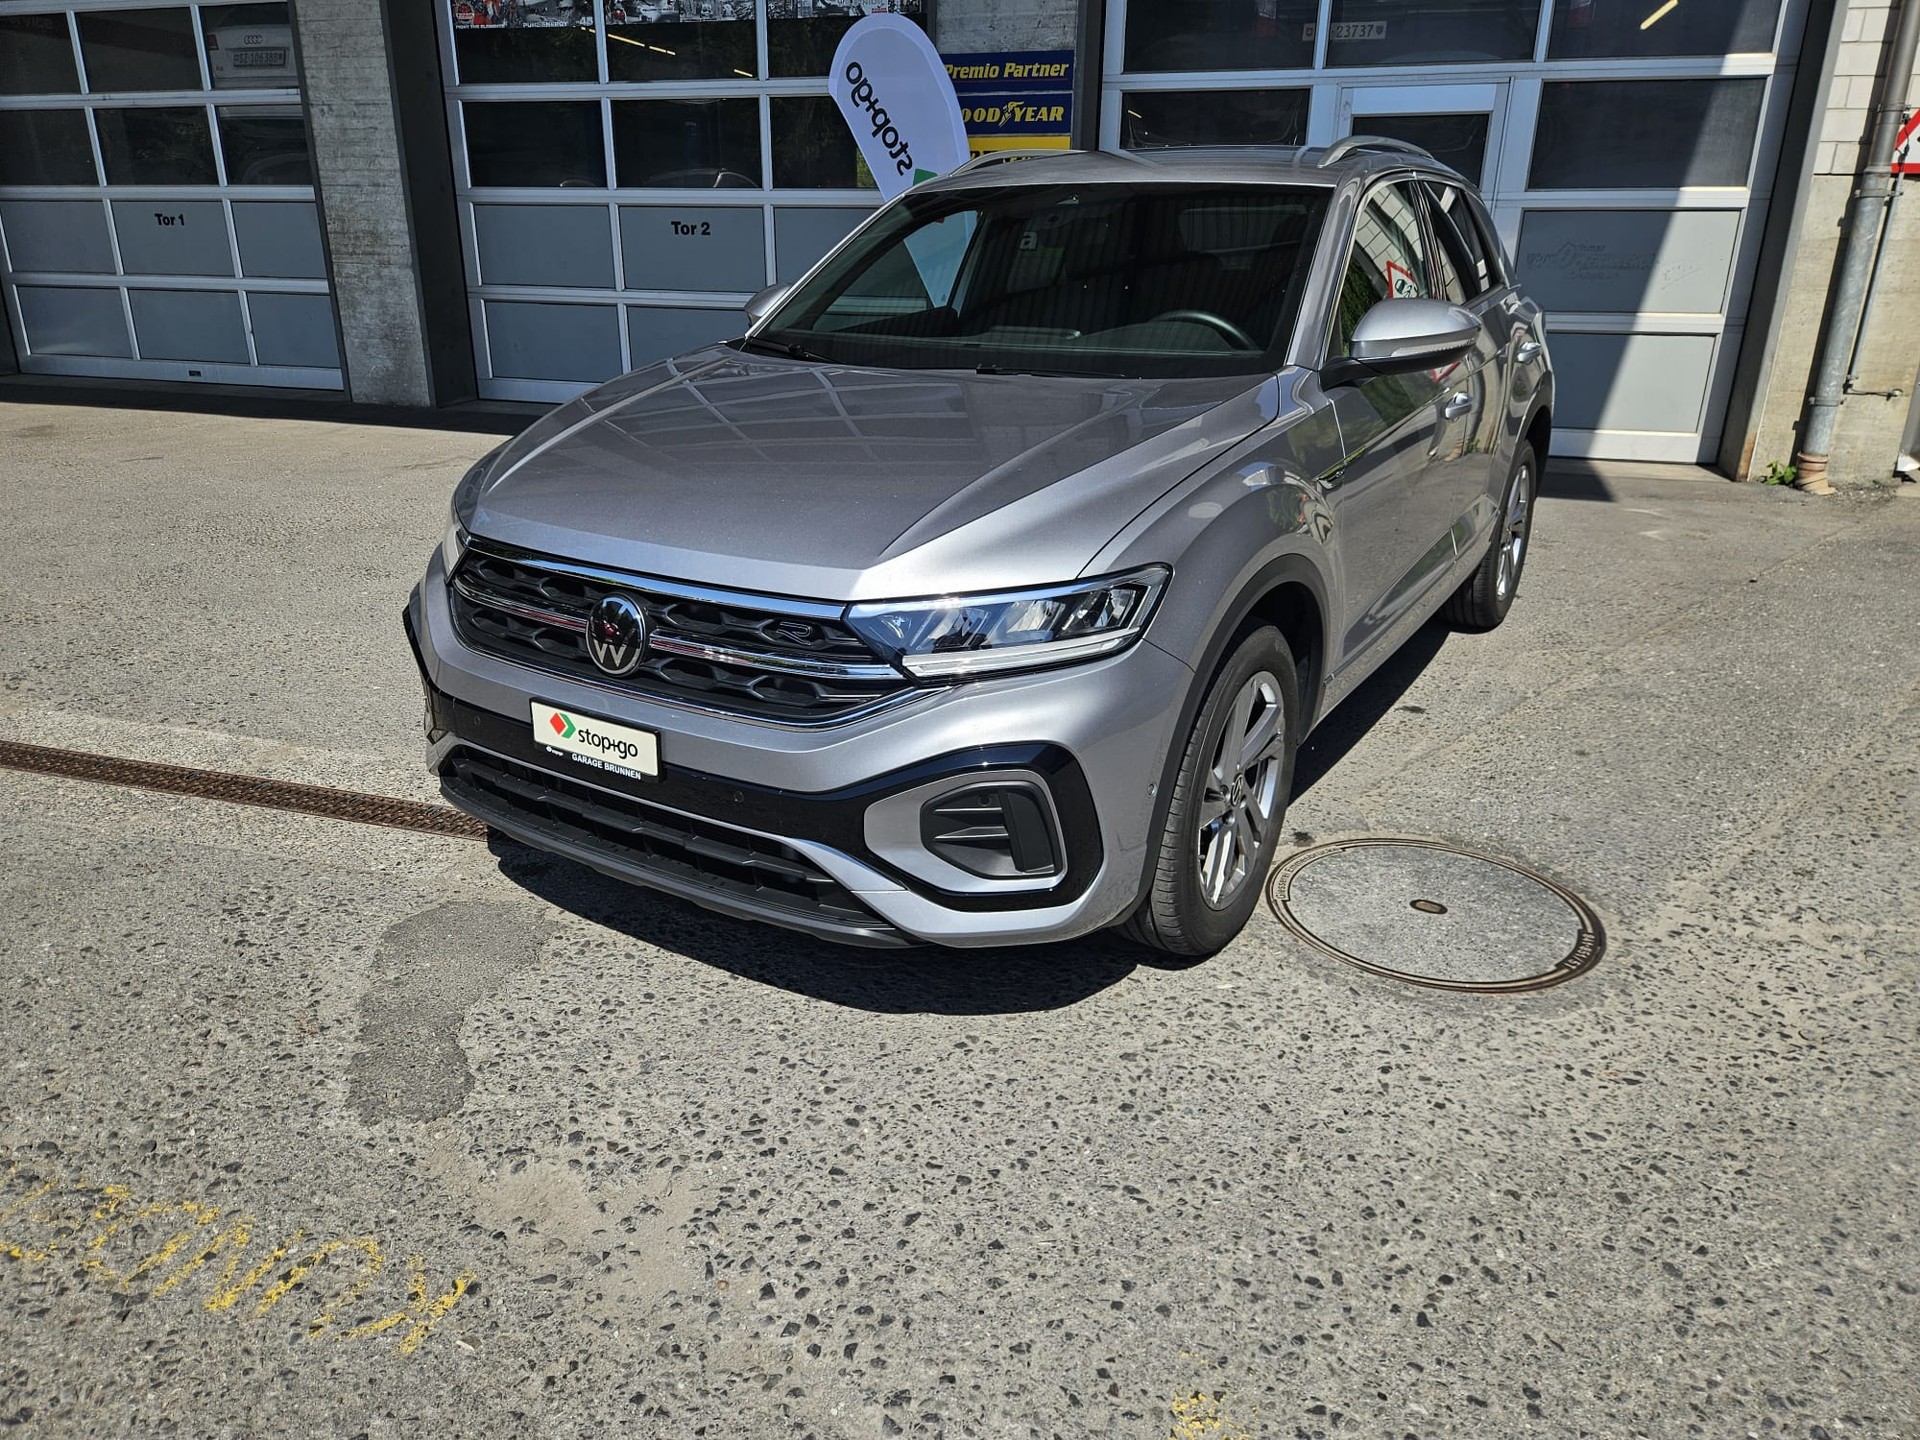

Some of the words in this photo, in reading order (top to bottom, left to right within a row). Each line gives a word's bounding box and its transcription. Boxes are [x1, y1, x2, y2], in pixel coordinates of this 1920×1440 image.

[945, 63, 1000, 79] Premio
[1003, 62, 1069, 78] Partner
[154, 213, 175, 226] Tor
[178, 213, 185, 226] 1
[671, 221, 697, 236] Tor
[700, 221, 711, 236] 2
[578, 728, 638, 760] stop+go
[571, 753, 603, 770] GARAGE
[604, 761, 641, 780] BRUNNEN
